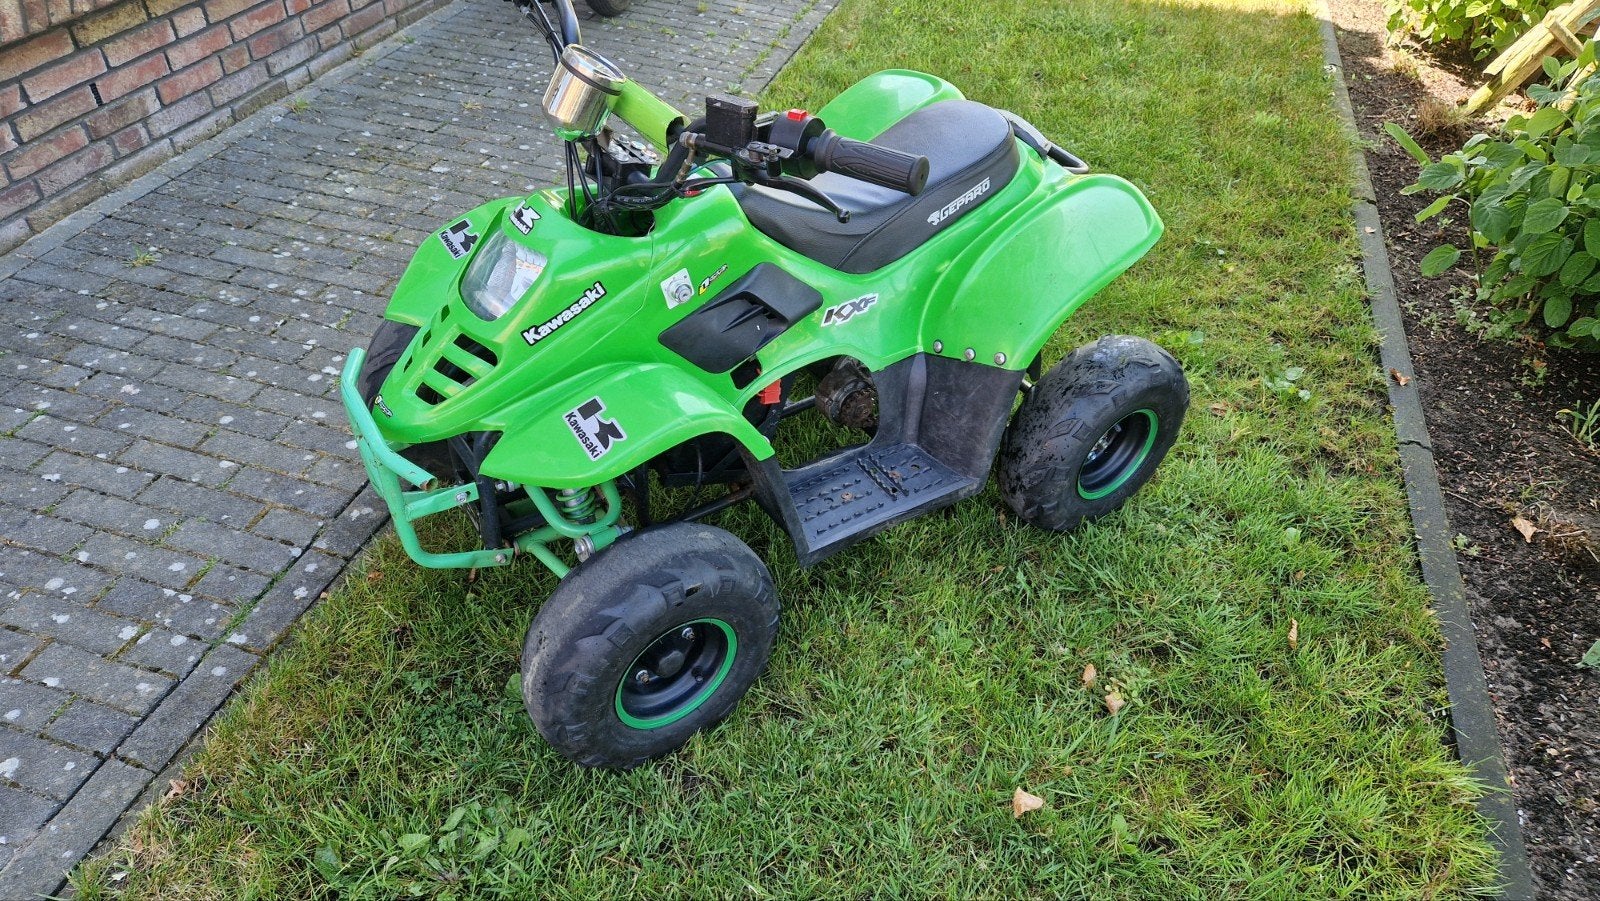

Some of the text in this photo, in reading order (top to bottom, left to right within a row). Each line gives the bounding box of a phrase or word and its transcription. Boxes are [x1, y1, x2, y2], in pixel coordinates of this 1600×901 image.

[940, 177, 991, 221] GEPARD
[439, 230, 464, 259] Kawasaki
[521, 281, 606, 345] Kawasaki
[823, 295, 877, 324] KXF
[565, 411, 603, 459] Kawasaki
